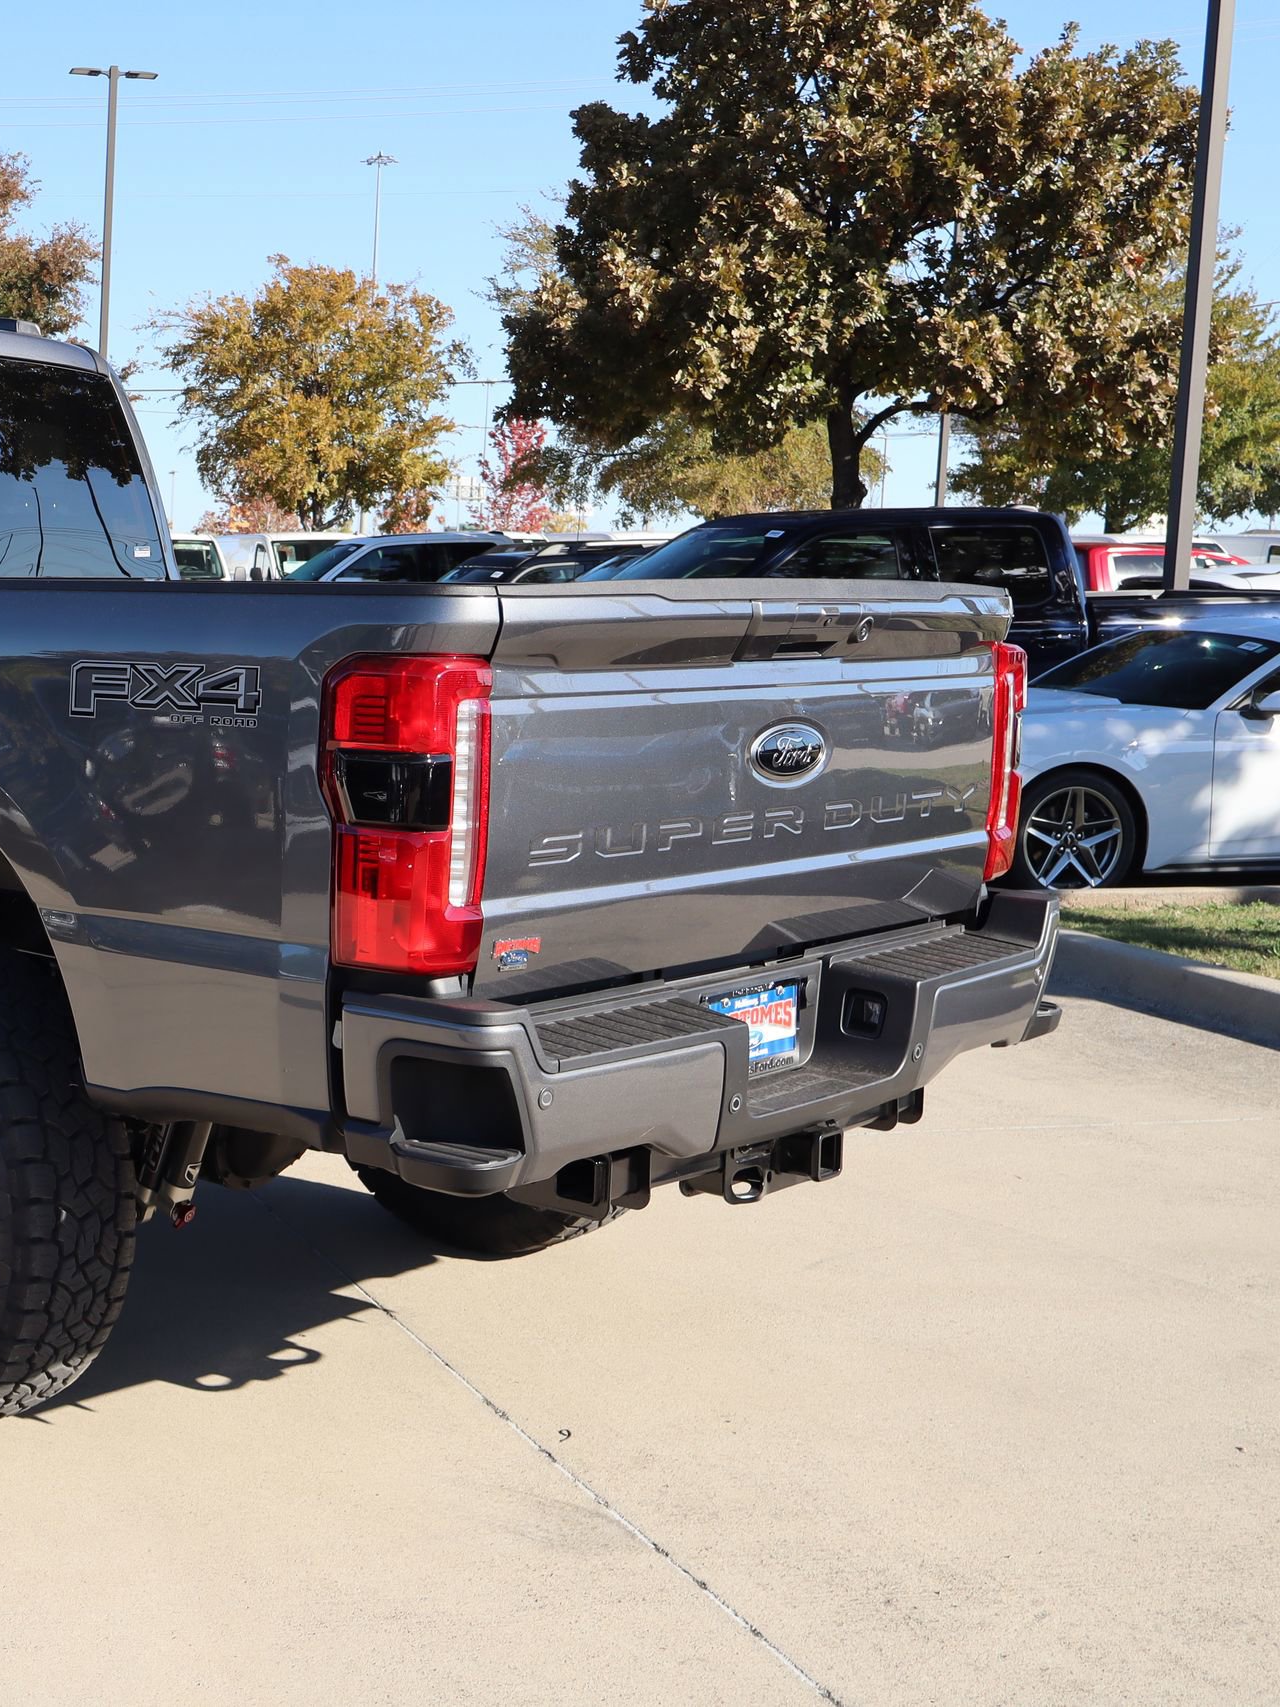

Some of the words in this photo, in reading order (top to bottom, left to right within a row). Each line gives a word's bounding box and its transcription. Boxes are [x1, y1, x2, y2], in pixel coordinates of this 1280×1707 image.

[69, 660, 262, 718] FX4
[170, 713, 204, 725] OFF
[209, 715, 258, 728] ROAD
[772, 736, 814, 767] Ford
[528, 805, 804, 867] SUPER
[823, 782, 978, 831] DUTY
